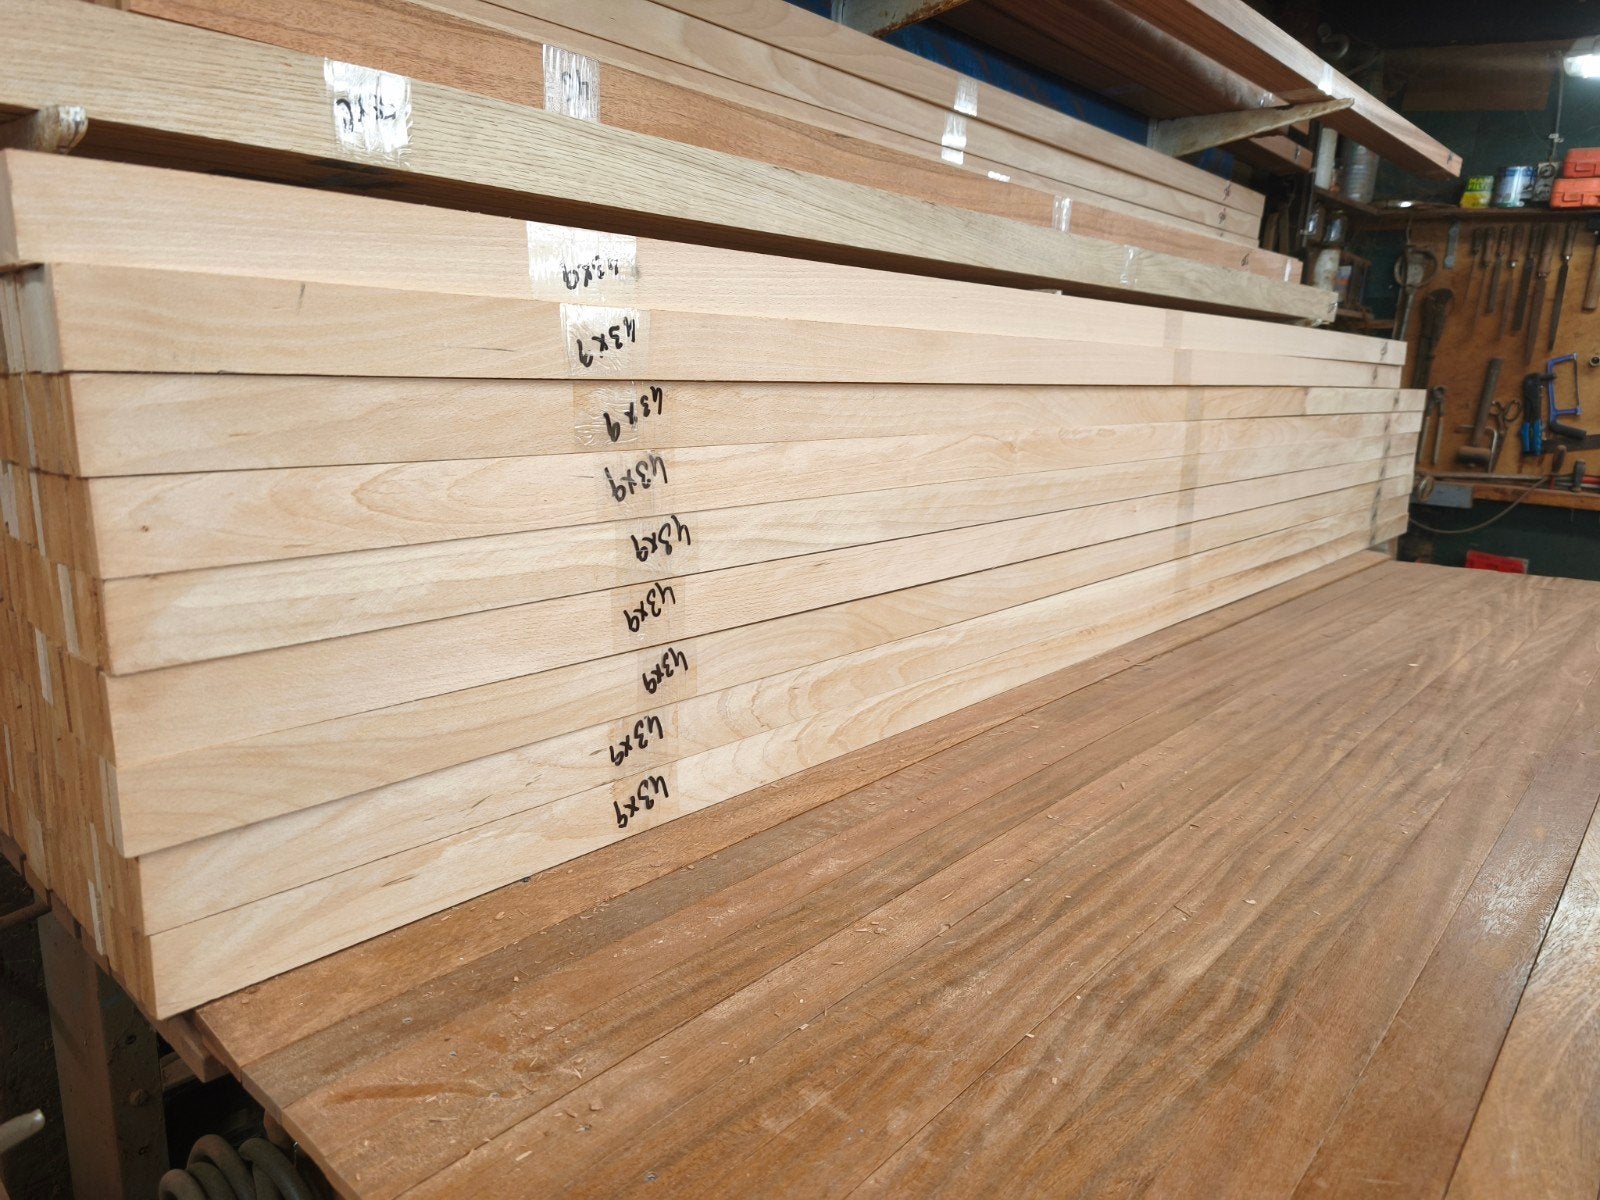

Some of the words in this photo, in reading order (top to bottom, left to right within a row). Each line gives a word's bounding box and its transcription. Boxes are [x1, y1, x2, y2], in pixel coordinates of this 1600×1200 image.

[576, 316, 636, 368] 43x9
[603, 385, 663, 442] 43x9
[604, 453, 668, 502] 43x9
[630, 515, 691, 562] 43x9
[623, 582, 676, 633] 43x9
[641, 647, 689, 694] 43x9
[609, 715, 664, 767] 43x9
[613, 775, 669, 829] 43x9
